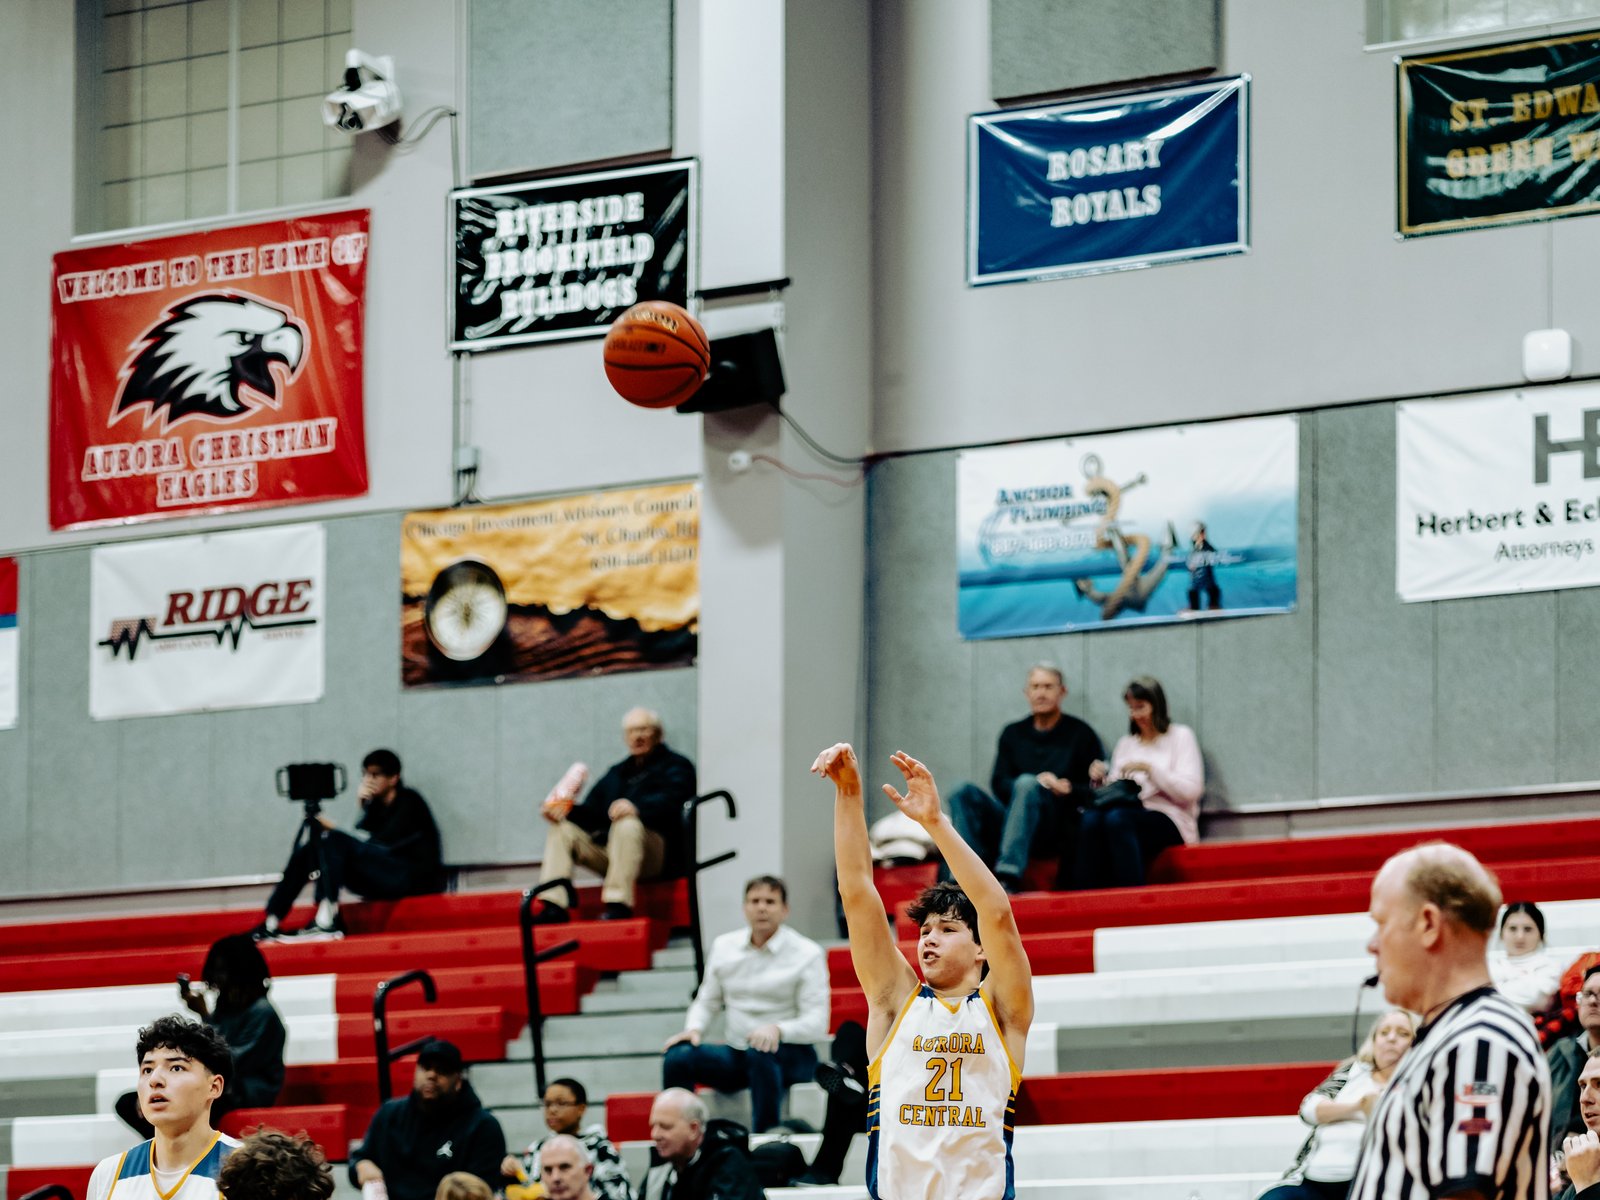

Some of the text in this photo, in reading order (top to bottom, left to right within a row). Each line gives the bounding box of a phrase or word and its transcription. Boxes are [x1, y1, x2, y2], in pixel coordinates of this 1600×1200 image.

[1047, 138, 1164, 181] ROSARY
[496, 192, 644, 237] RIVERSIDE
[1050, 185, 1161, 228] ROYALS
[58, 261, 166, 303] WELCOME
[170, 255, 200, 288] TO
[206, 248, 255, 281] THE
[259, 237, 330, 275] HOME
[484, 232, 655, 281] BROOKFIELD
[501, 275, 637, 320] BULLDOGS
[82, 417, 337, 481] AURORA CHRISTIAN
[156, 464, 258, 507] EAGLES
[1416, 509, 1524, 536] Herbert
[1535, 502, 1552, 525] &
[1495, 539, 1594, 562] Attorneys
[163, 579, 312, 626] RIDGE
[912, 1032, 986, 1054] AURORA
[924, 1057, 964, 1102] 21
[899, 1104, 986, 1127] CENTRAL
